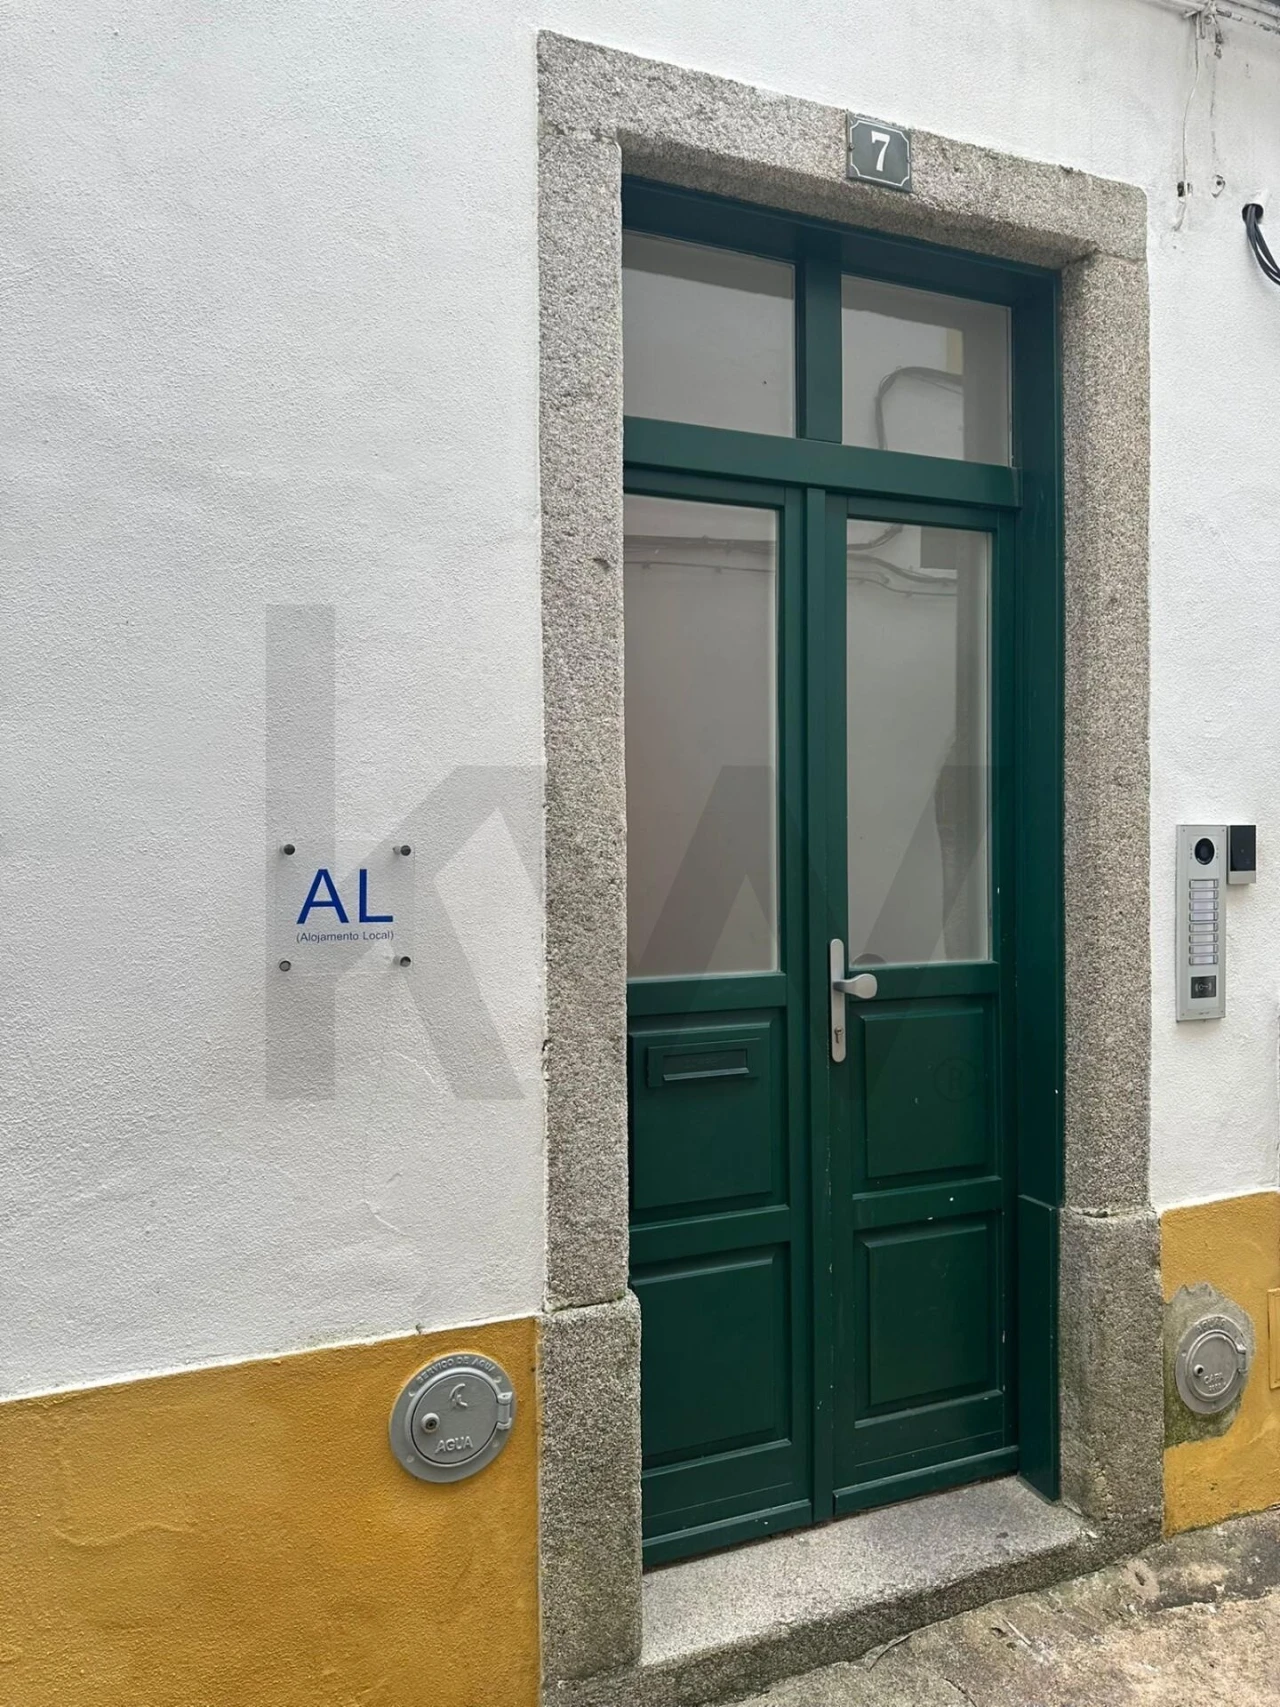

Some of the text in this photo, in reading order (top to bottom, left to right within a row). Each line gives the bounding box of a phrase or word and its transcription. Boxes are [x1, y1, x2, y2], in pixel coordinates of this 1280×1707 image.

[871, 130, 890, 172] 7
[296, 868, 394, 925] AL
[296, 930, 394, 944] (Alojamento Local)
[456, 1356, 470, 1366] DE
[434, 1435, 474, 1455] AGUA
